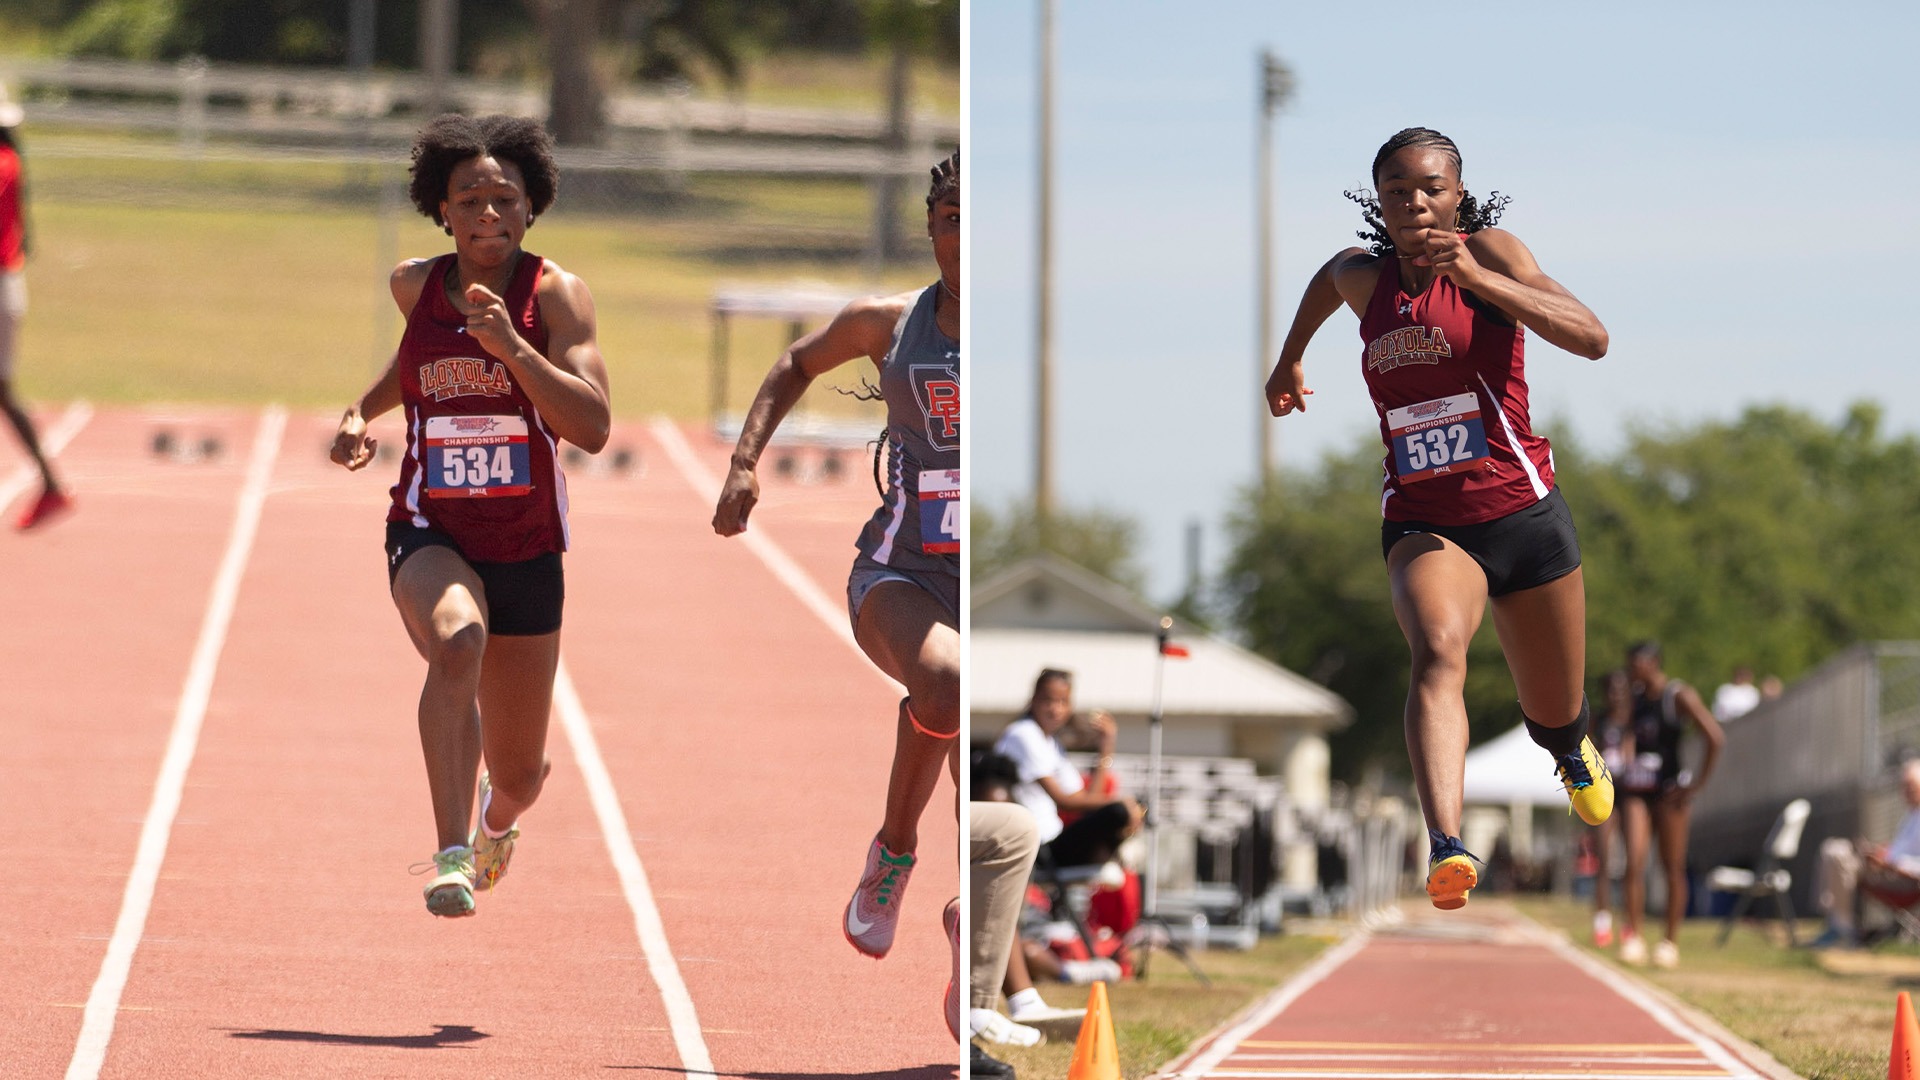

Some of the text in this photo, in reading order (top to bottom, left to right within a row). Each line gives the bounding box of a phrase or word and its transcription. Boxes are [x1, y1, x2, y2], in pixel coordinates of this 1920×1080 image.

[1369, 326, 1452, 371] LOYOLA
[420, 358, 511, 397] LOYOLA
[444, 437, 510, 445] CHAMPIONSHIP
[1405, 415, 1463, 433] CHAMPIONSHIP
[443, 447, 513, 486] 534
[1405, 424, 1473, 470] 532
